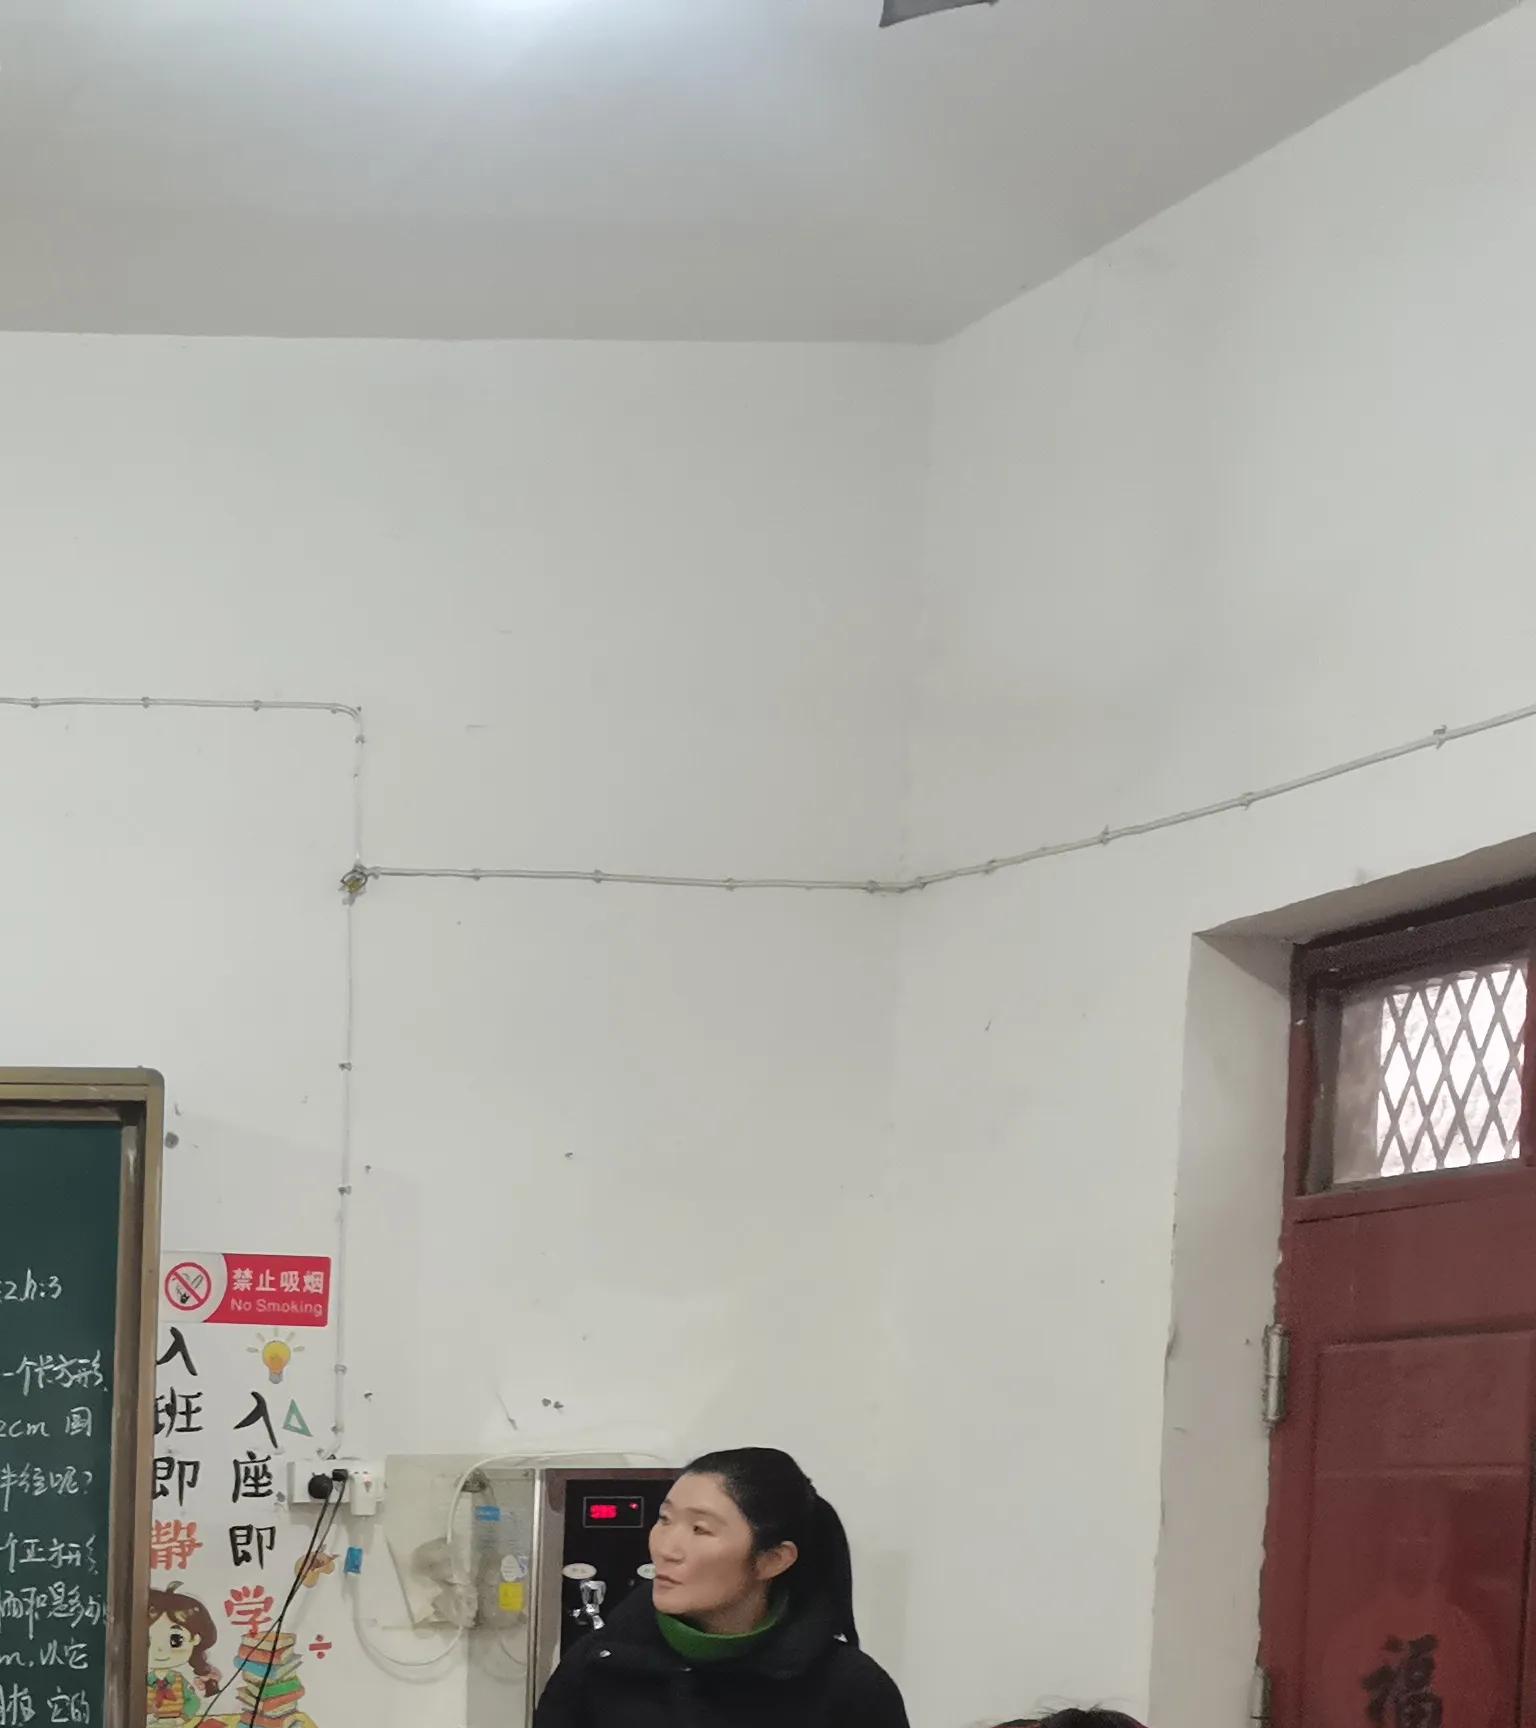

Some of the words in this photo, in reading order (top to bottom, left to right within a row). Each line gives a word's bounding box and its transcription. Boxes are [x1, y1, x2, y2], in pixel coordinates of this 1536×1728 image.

[230, 1298, 252, 1312] No
[255, 1299, 323, 1318] Smoking
[231, 1267, 325, 1294] 禁止吸烟
[150, 1326, 204, 1571] 入班即静
[224, 1391, 278, 1637] 入座即学
